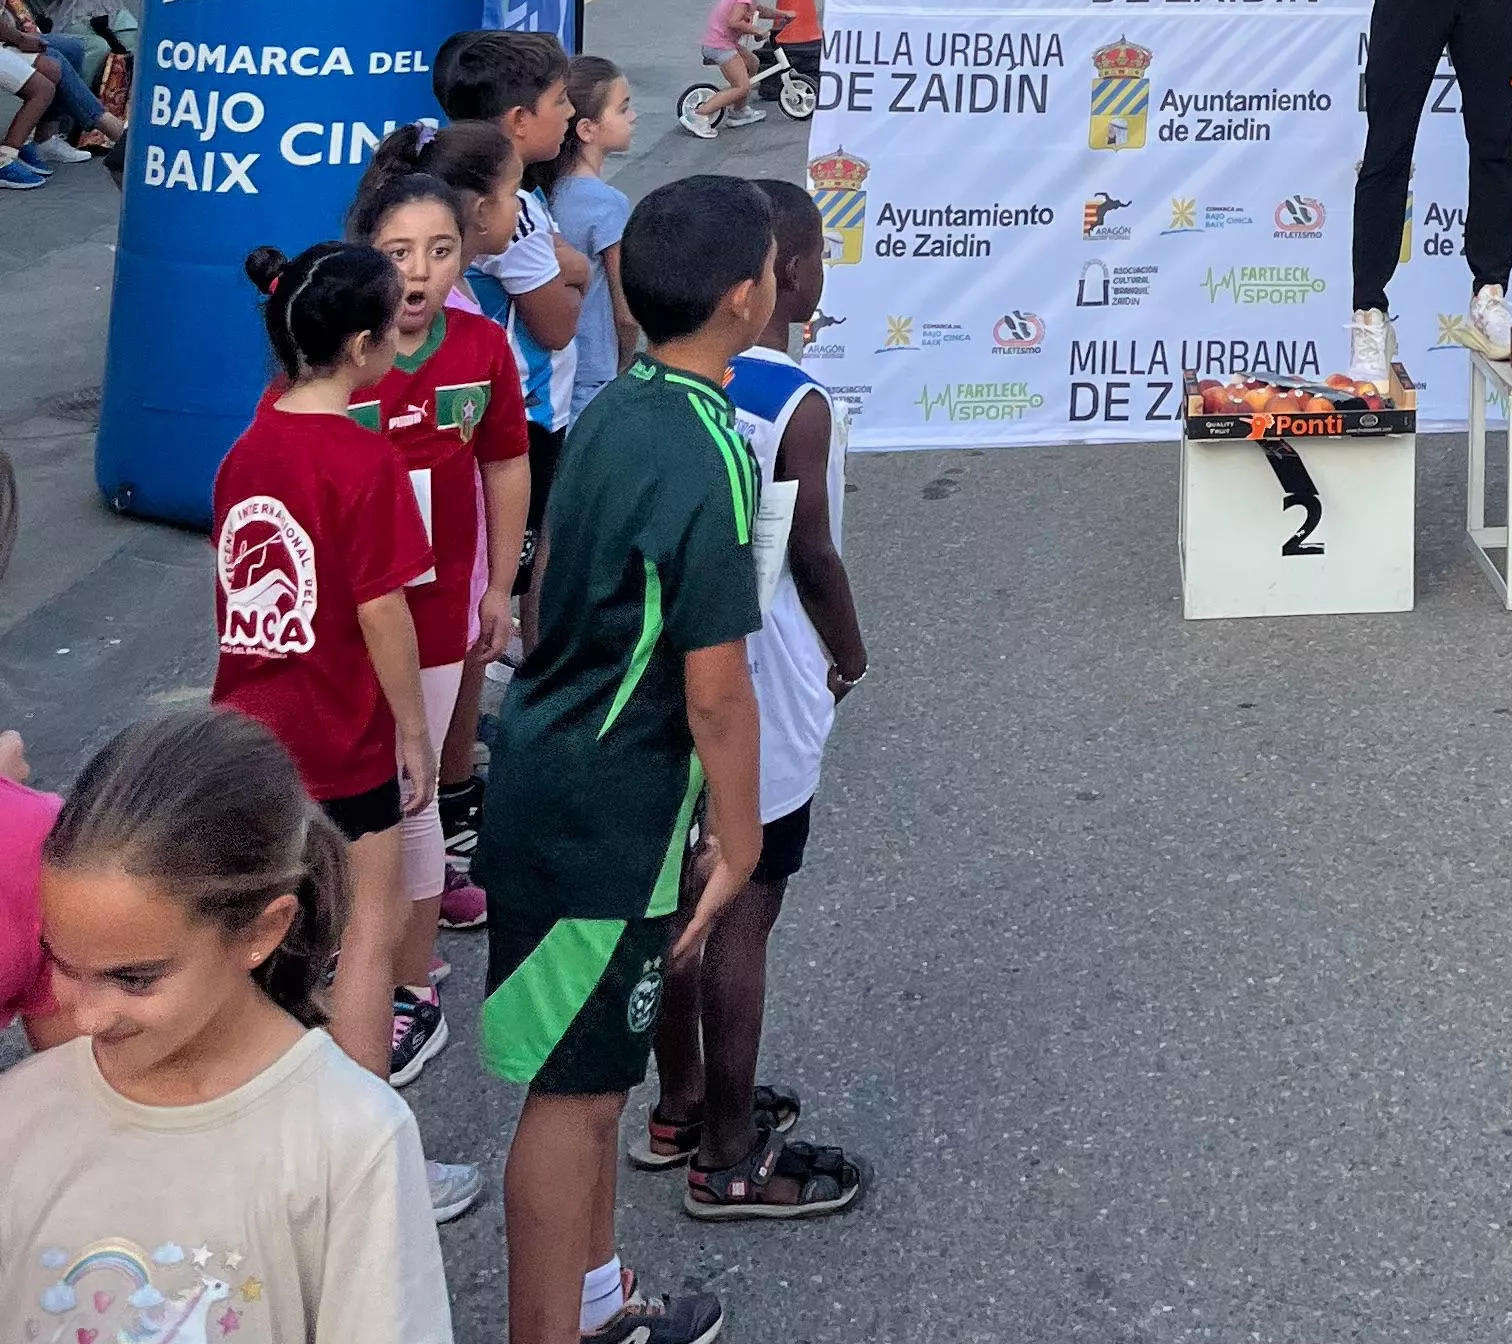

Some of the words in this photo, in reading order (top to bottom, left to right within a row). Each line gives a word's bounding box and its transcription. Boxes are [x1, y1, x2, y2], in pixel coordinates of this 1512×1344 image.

[157, 39, 354, 76] COMARCA
[368, 50, 430, 75] DEL
[822, 30, 913, 65] MILLA
[926, 32, 1064, 67] URBANA
[815, 71, 874, 112] DE
[889, 62, 1048, 113] ZAIDÍN
[150, 85, 265, 142] BAJO
[1159, 88, 1332, 117] Ayuntamiento
[279, 118, 440, 166] CIN
[1159, 119, 1188, 142] de
[1195, 118, 1270, 142] Zaidin
[144, 146, 260, 194] BAIX
[876, 203, 1054, 232] Ayuntamiento
[875, 234, 906, 257] de
[912, 233, 991, 257] Zaidin
[1273, 231, 1322, 239] ATLETISMO
[1424, 234, 1454, 257] de
[1240, 267, 1310, 282] FARTLECK
[1243, 289, 1310, 304] SPORT
[992, 347, 1042, 355] ATLETISMO
[1069, 340, 1169, 375] MILLA
[1181, 340, 1321, 375] URBANA
[957, 382, 1028, 399] FARTLECK
[1069, 382, 1131, 422] DE
[958, 404, 1025, 421] SPORT
[1275, 414, 1344, 437] Ponti
[1281, 493, 1325, 556] 2
